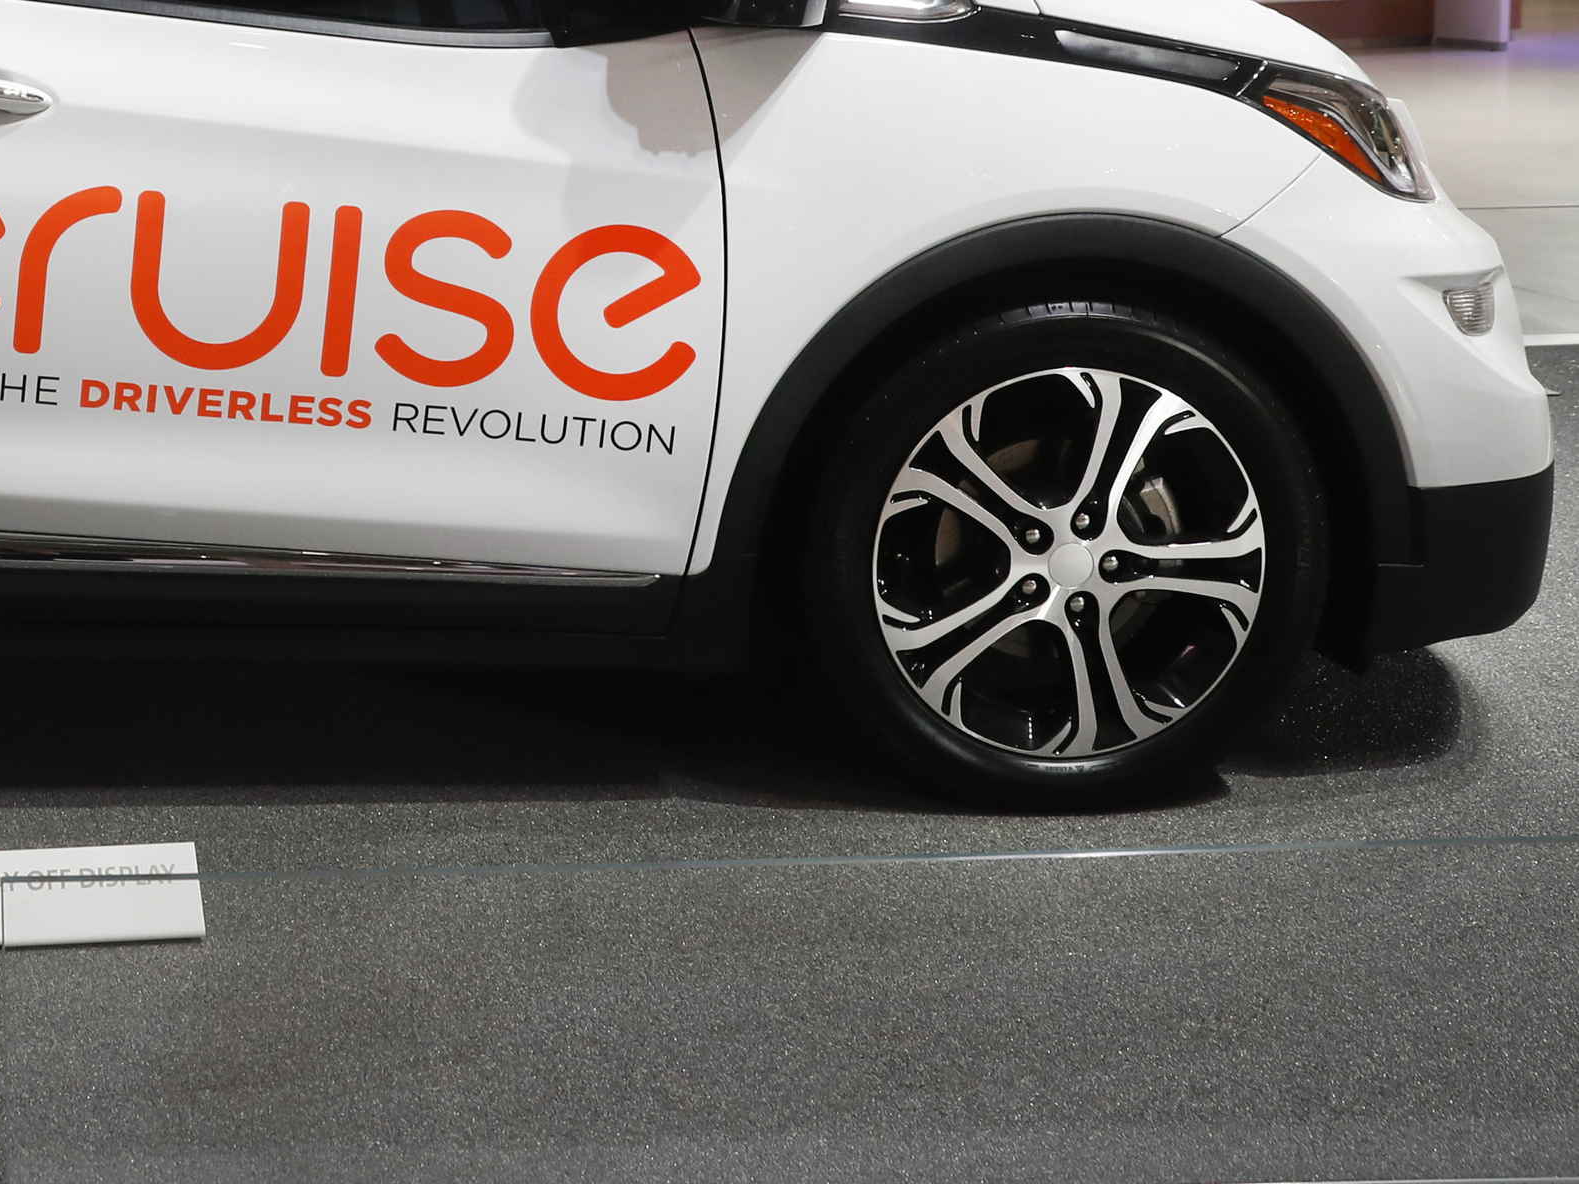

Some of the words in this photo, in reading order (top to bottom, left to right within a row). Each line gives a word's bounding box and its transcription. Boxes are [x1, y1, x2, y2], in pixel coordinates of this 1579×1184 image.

[80, 379, 372, 429] DRIVERLESS
[392, 402, 676, 455] REVOLUTION
[26, 868, 71, 892] OFF
[78, 863, 176, 889] DISPLAY
